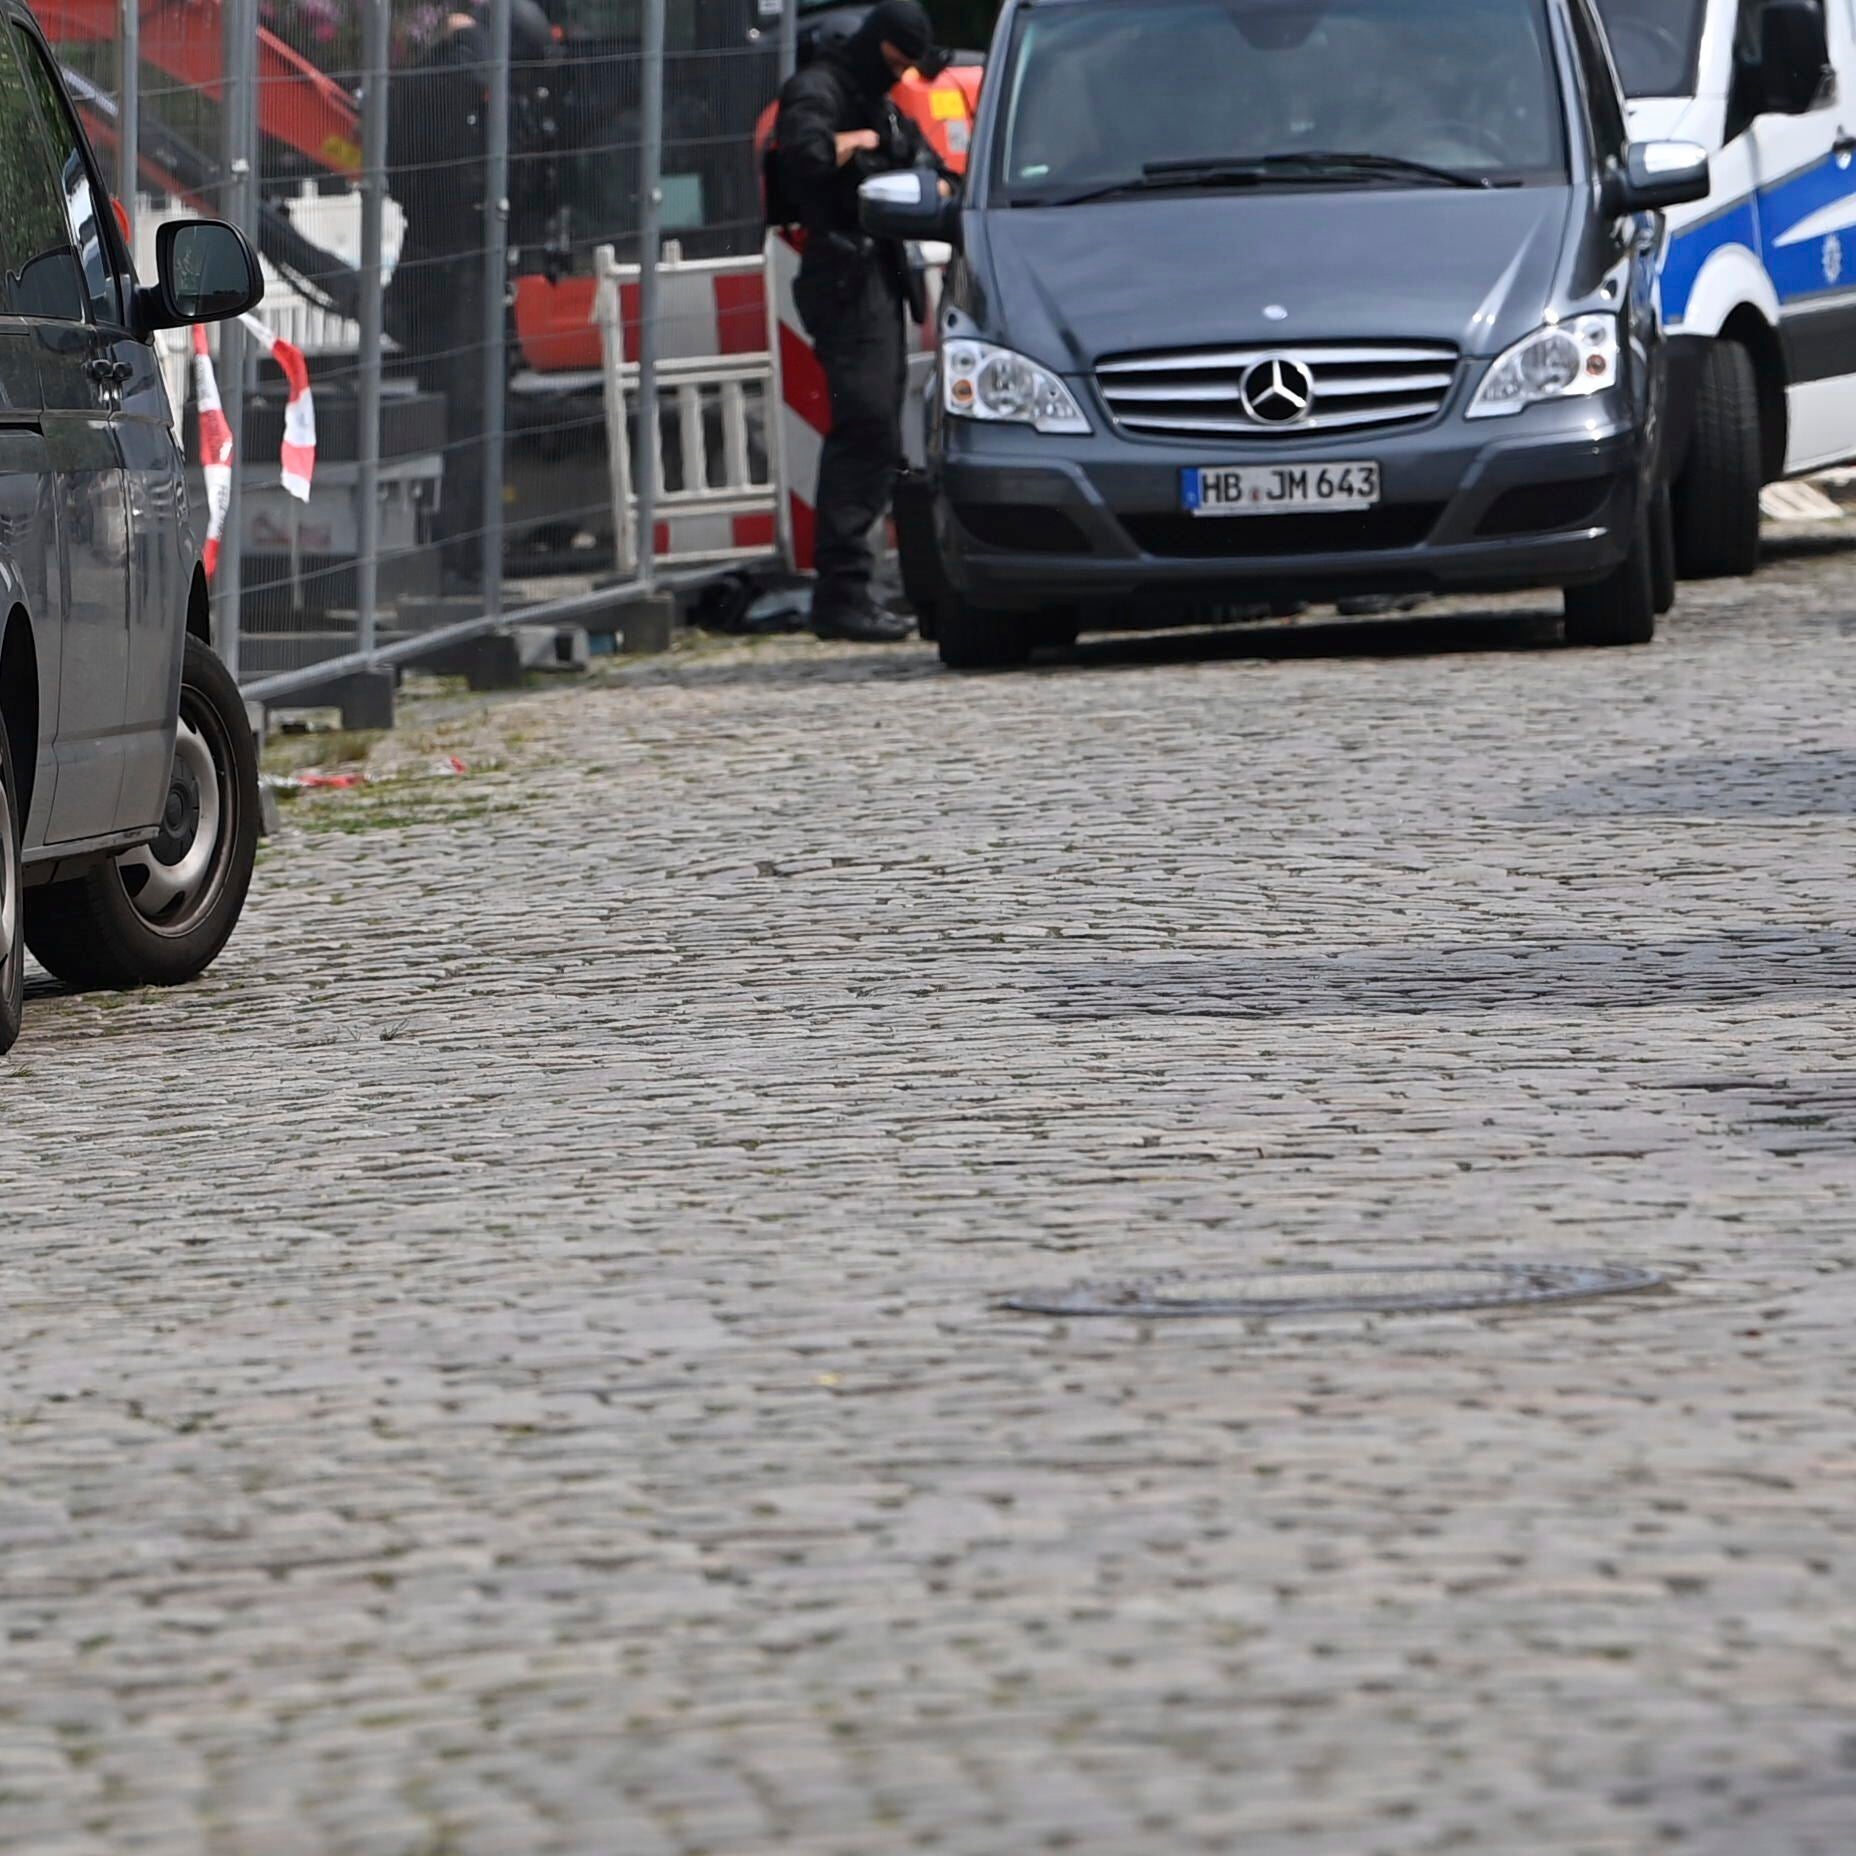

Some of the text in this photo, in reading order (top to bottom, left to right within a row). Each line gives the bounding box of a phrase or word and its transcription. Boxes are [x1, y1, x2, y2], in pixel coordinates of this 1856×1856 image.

[1201, 467, 1375, 503] HB JM 643
